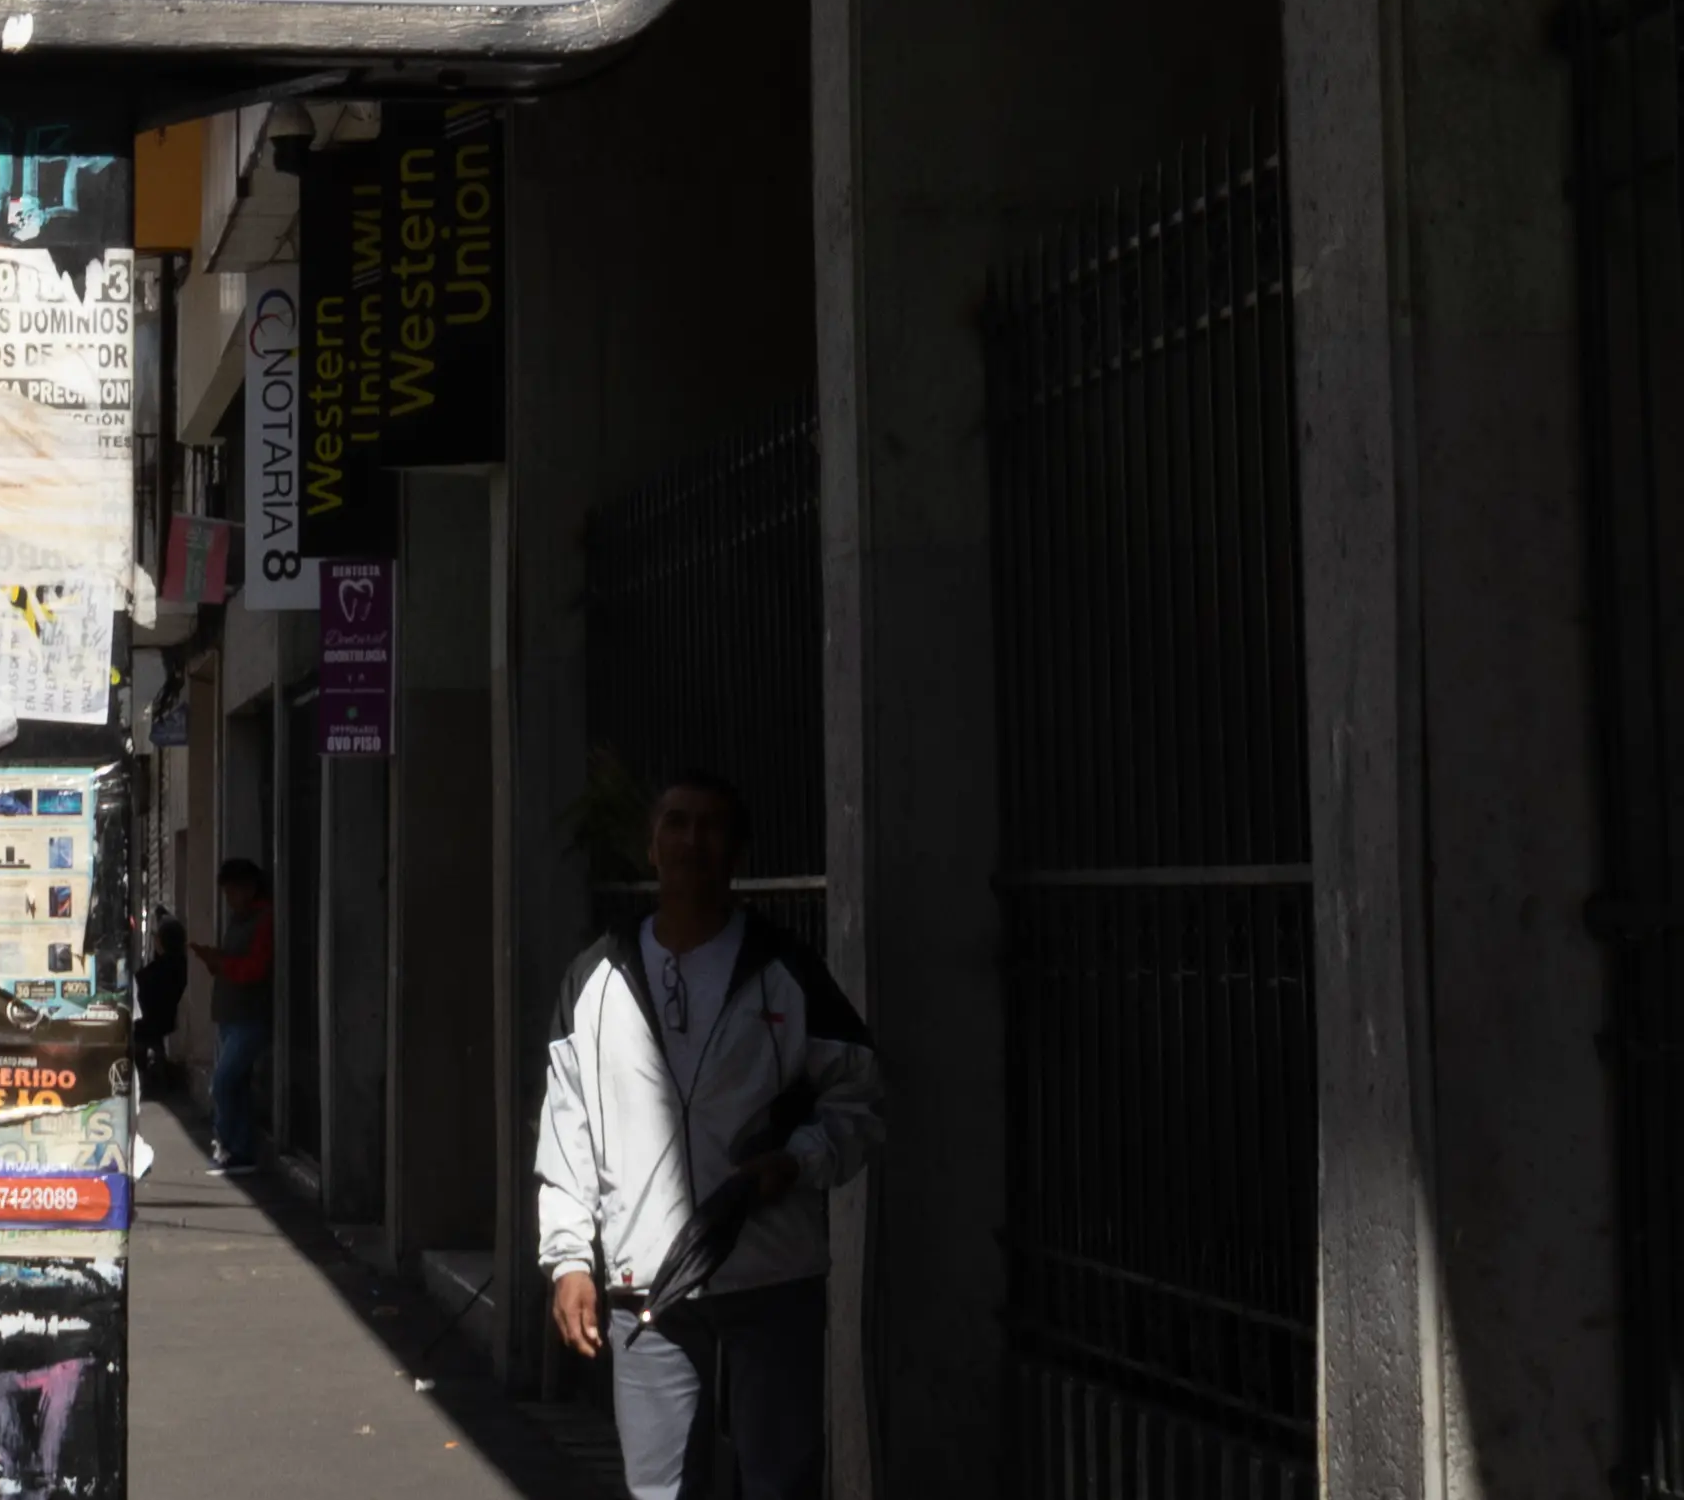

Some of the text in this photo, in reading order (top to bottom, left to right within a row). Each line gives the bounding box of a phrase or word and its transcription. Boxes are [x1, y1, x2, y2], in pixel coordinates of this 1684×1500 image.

[388, 149, 437, 417] Western
[441, 143, 491, 325] Union
[306, 296, 344, 516] Western
[262, 549, 301, 582] 8
